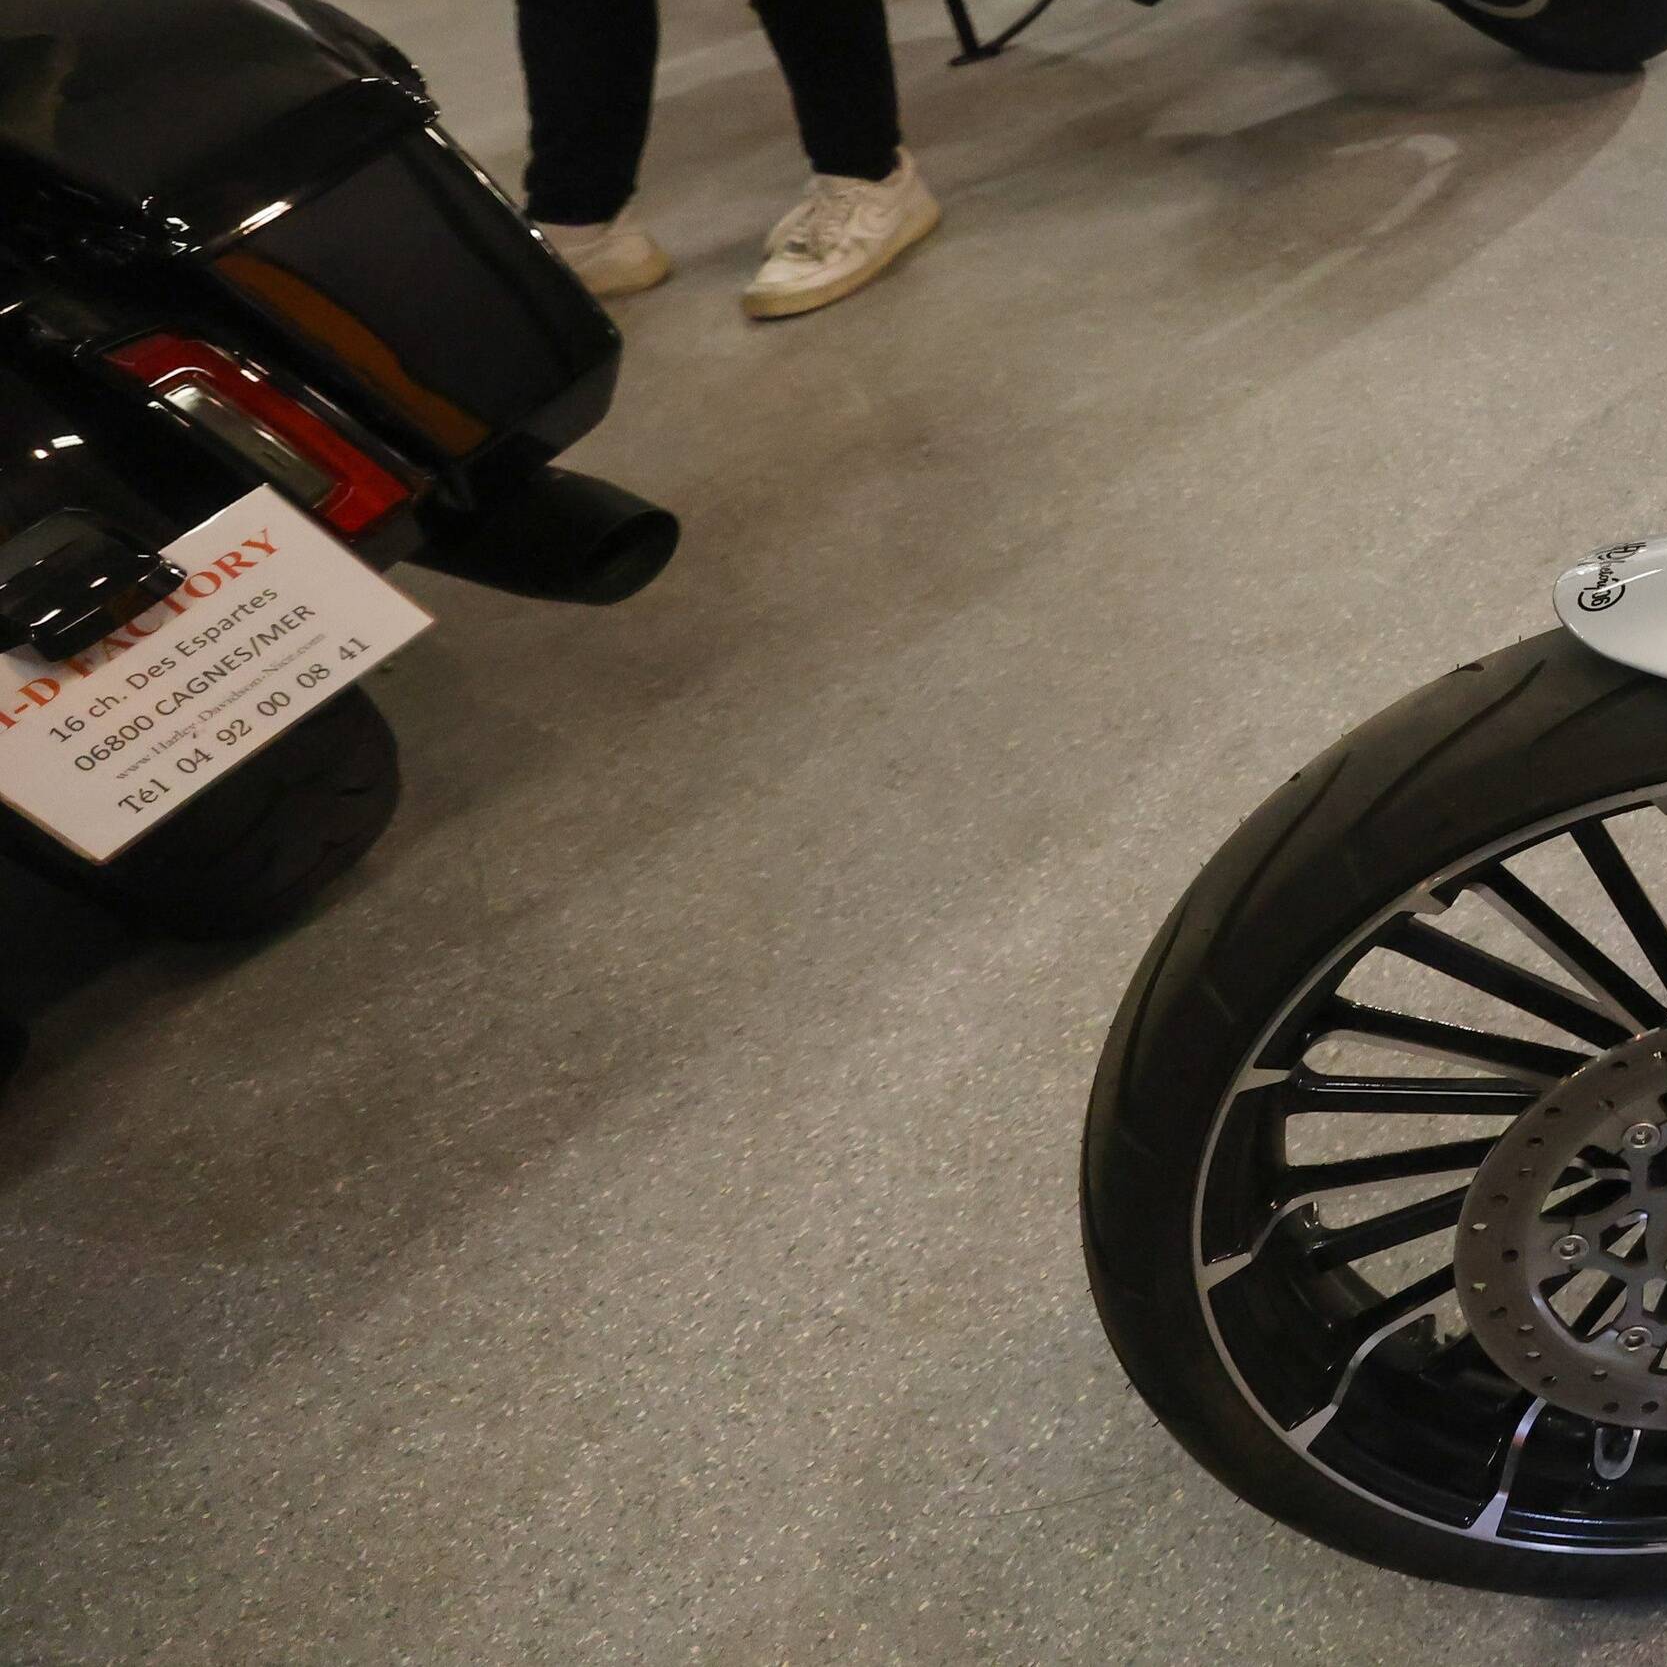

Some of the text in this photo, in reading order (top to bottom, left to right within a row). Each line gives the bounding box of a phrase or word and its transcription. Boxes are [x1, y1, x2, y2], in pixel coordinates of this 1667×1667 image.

[50, 587, 278, 742] 16 ch. Des Espartes
[74, 605, 316, 772] 06800 CAGNES/MER
[118, 637, 371, 814] Tél 04 92 00 08 41
